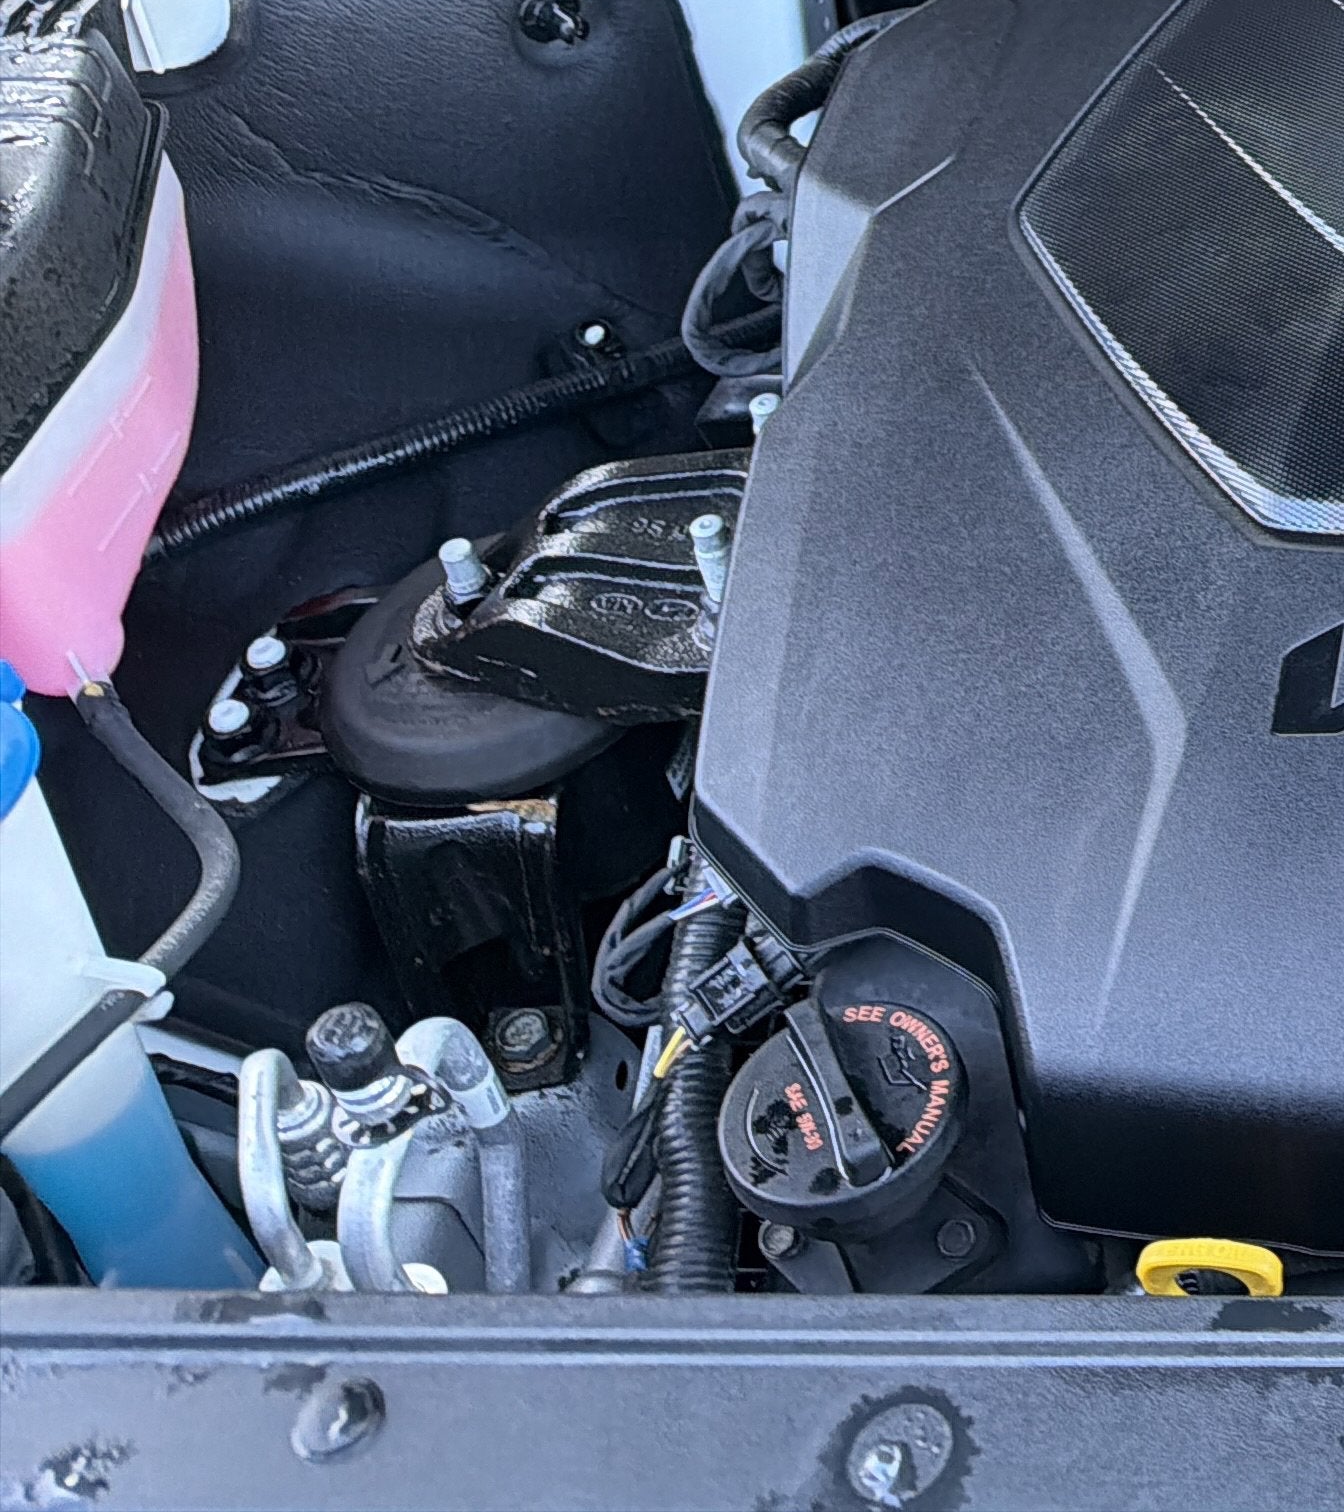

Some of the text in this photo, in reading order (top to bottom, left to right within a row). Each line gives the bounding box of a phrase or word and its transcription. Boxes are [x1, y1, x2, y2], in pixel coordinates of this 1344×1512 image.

[842, 1005, 950, 1153] SEE OWNER'S MANUAL
